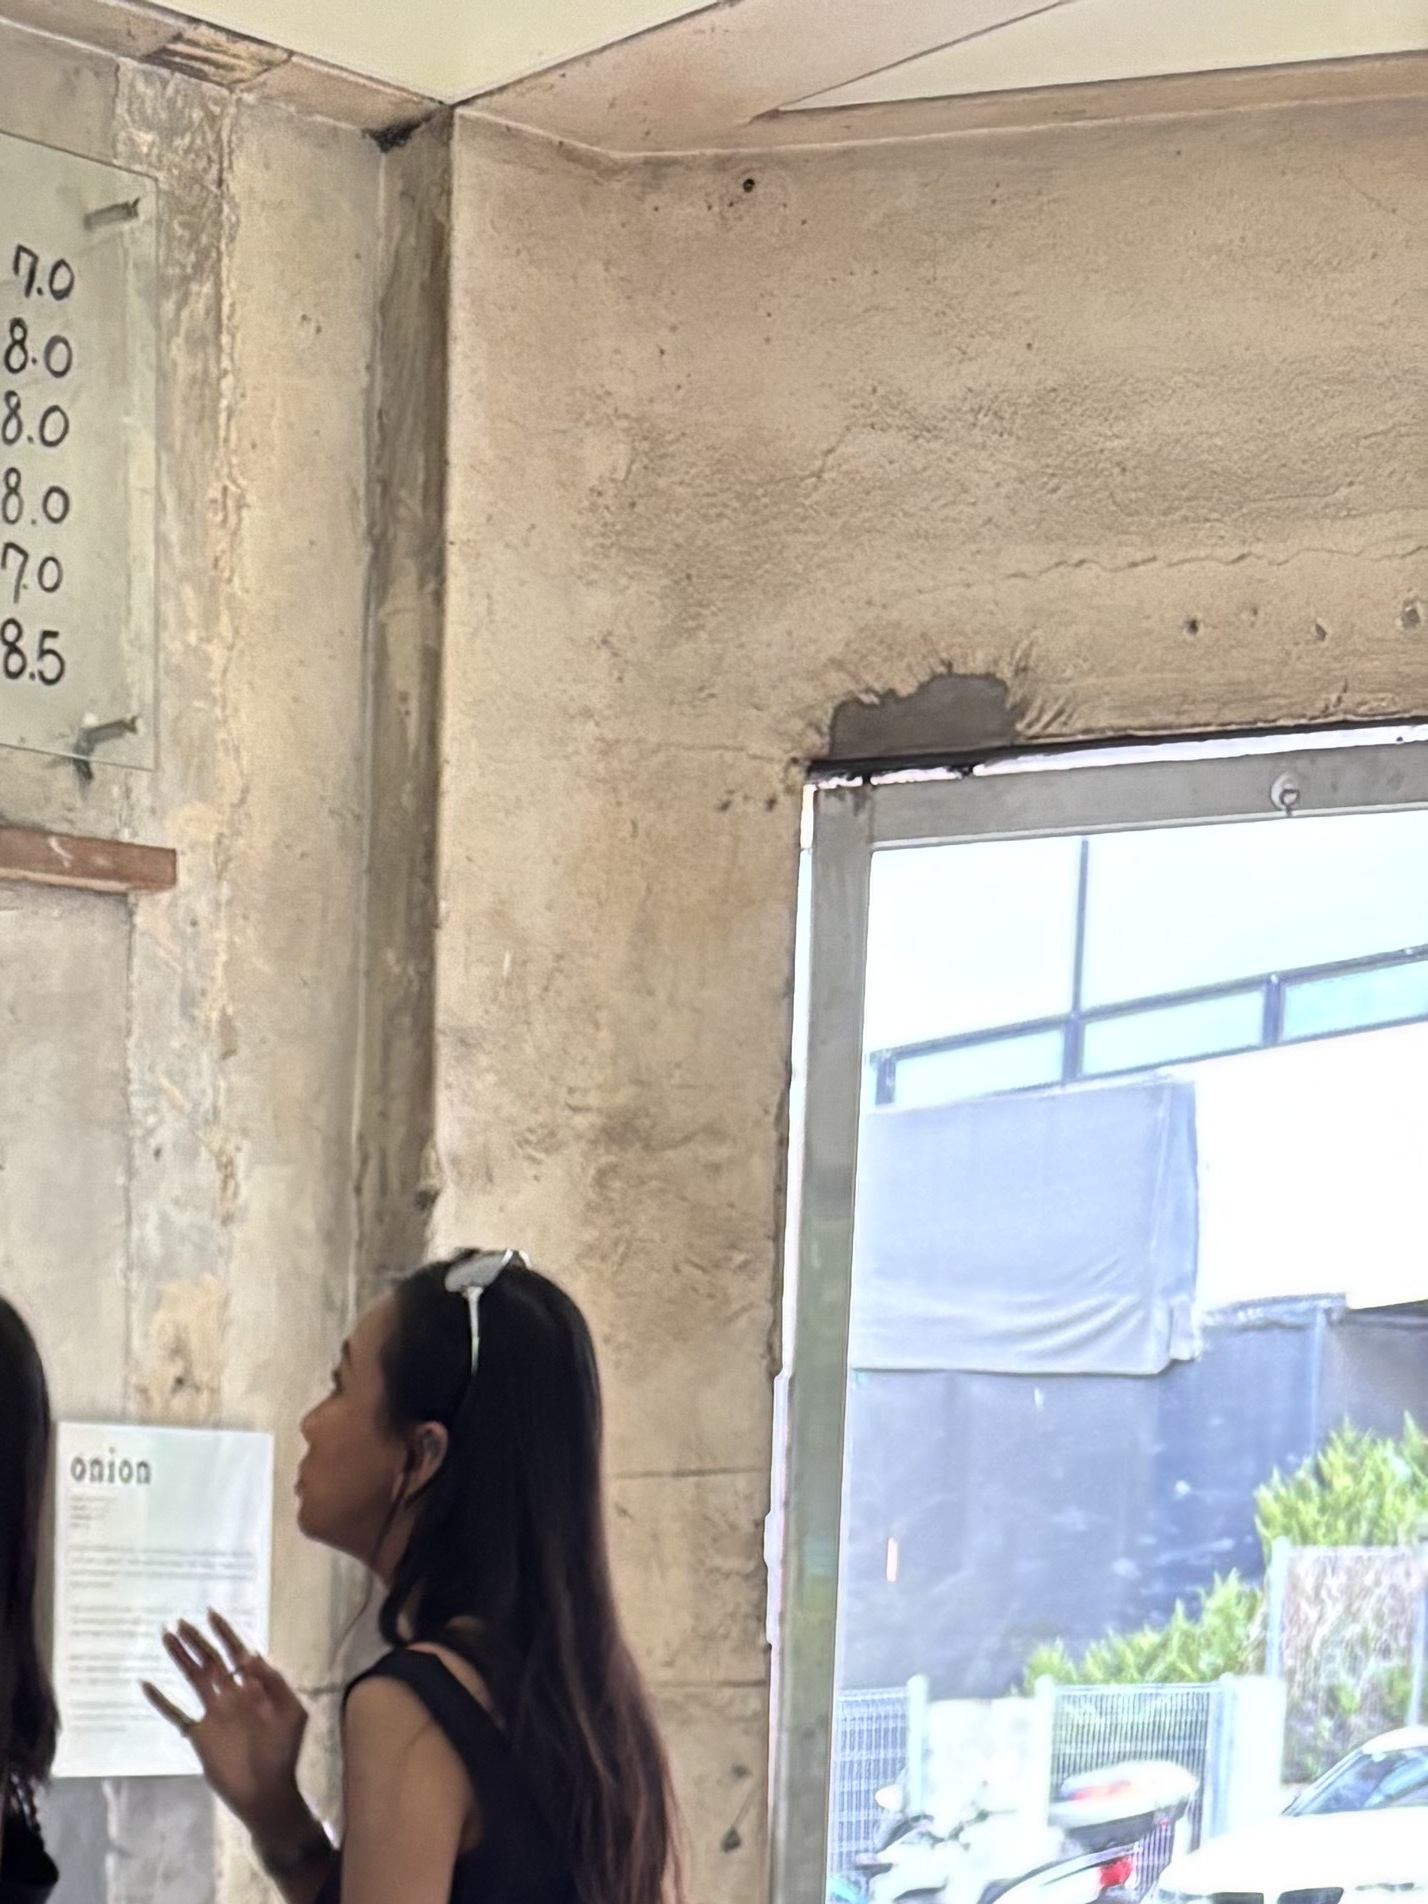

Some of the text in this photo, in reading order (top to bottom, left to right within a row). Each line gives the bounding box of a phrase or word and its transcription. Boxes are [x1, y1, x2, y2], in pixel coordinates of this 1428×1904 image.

[13, 244, 75, 301] 7.0
[4, 317, 74, 379] 8.0
[1, 390, 70, 447] 8.0
[1, 467, 71, 525] 8.0
[1, 541, 64, 604] 7.0
[0, 617, 65, 686] 8.5
[70, 1448, 152, 1485] onion
